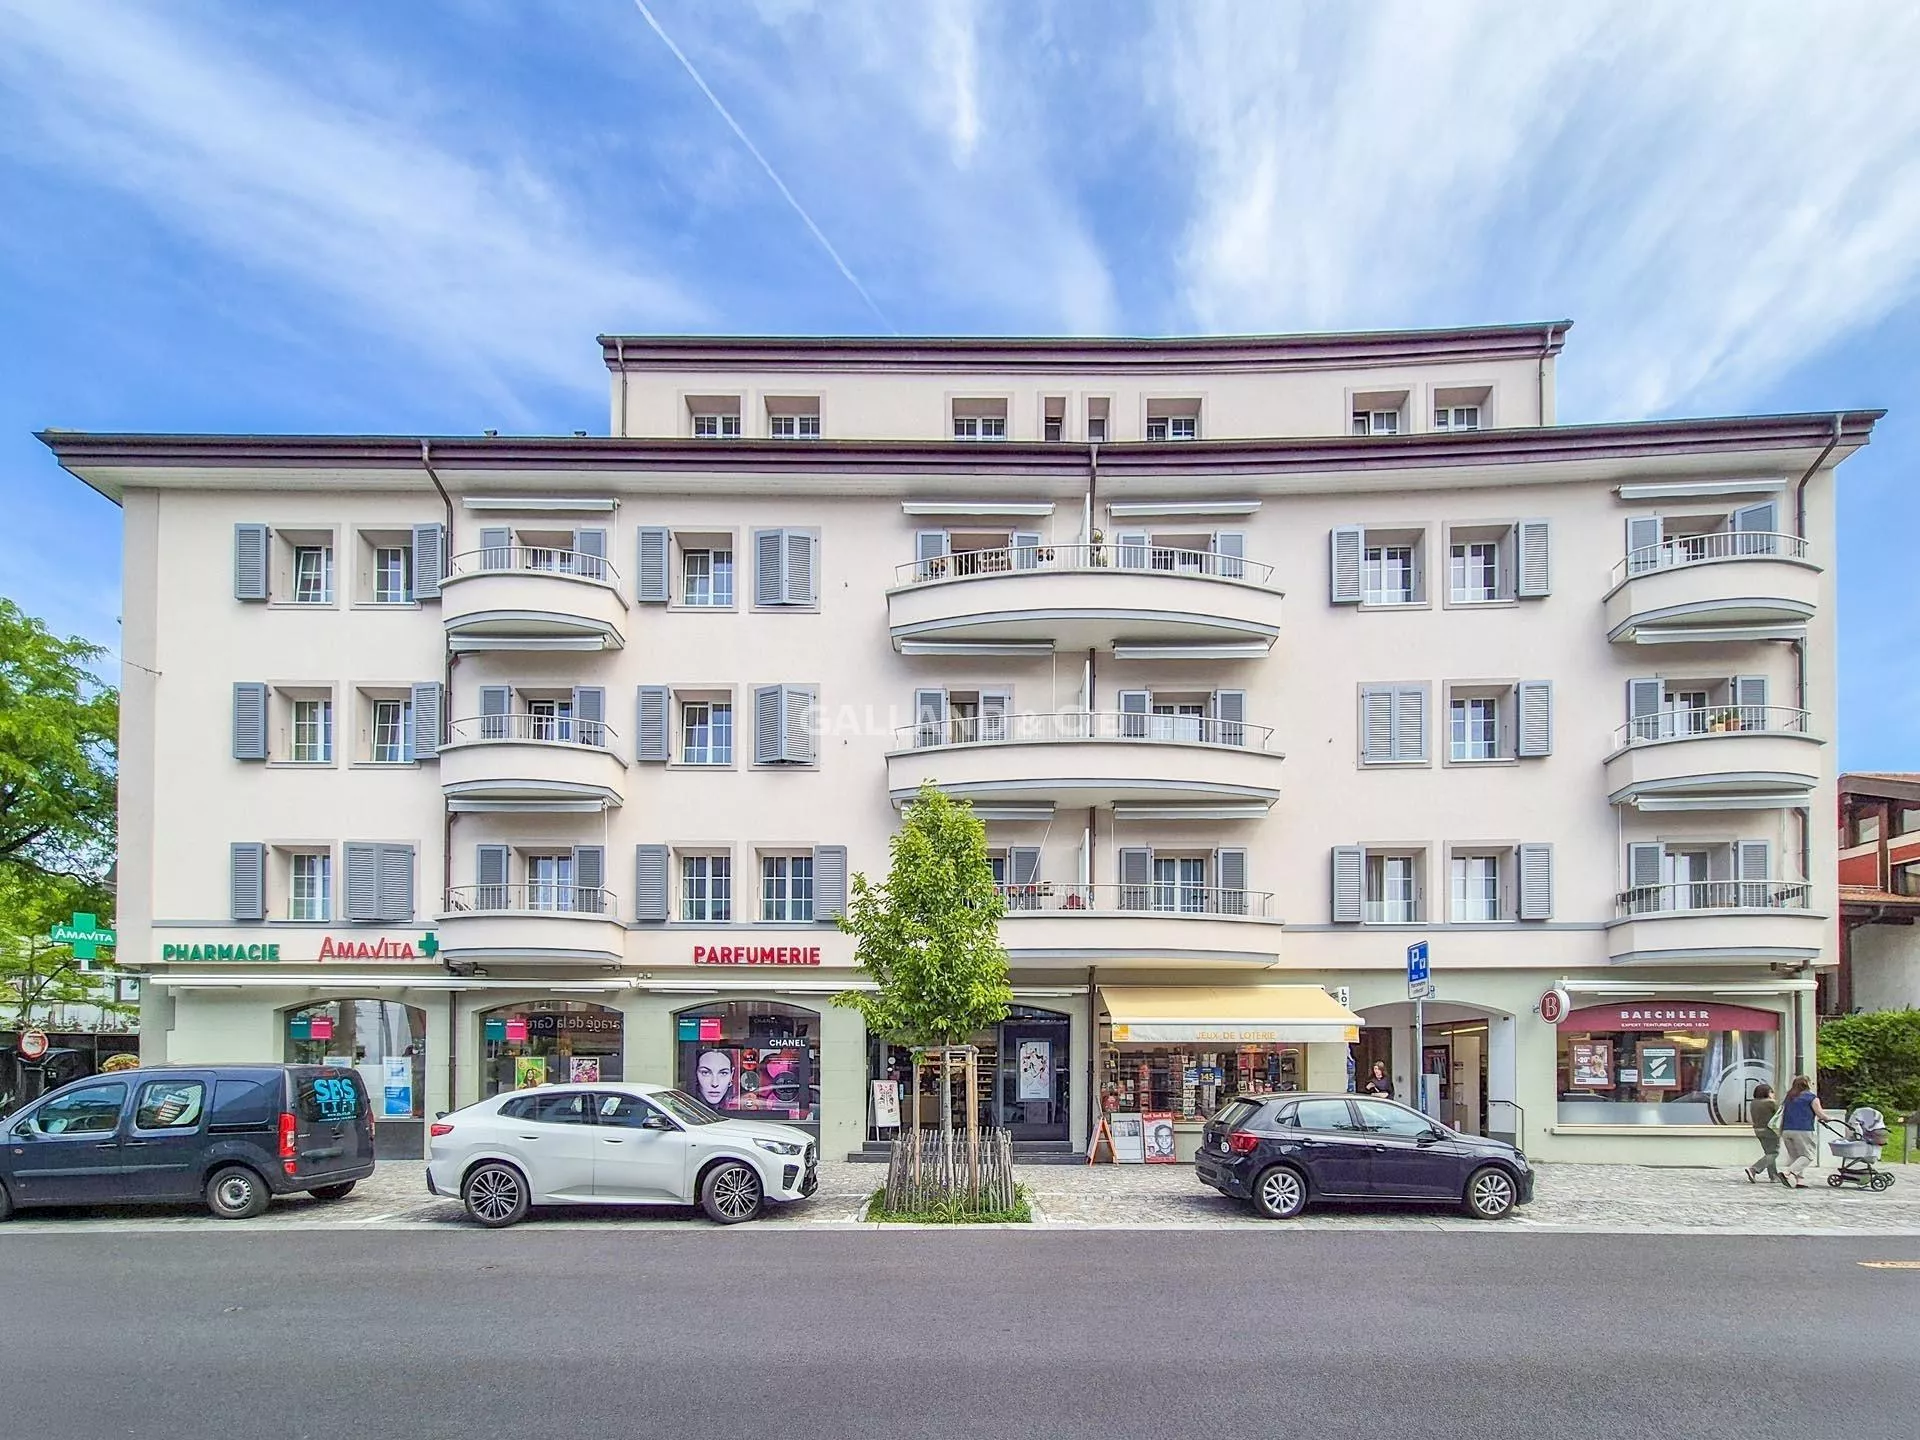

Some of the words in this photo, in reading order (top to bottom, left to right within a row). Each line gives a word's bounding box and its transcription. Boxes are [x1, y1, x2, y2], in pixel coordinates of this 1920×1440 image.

[163, 943, 280, 962] PHARMACIE
[318, 936, 415, 963] AMAVITA
[693, 945, 821, 966] PARFUMERIE
[1411, 949, 1420, 971] P
[1545, 996, 1558, 1017] B
[1620, 1010, 1710, 1020] BAECHLER
[769, 1039, 806, 1047] CHANEL
[1196, 1031, 1218, 1040] JEUX
[1222, 1031, 1235, 1040] DE
[1239, 1031, 1276, 1040] LOTERIE
